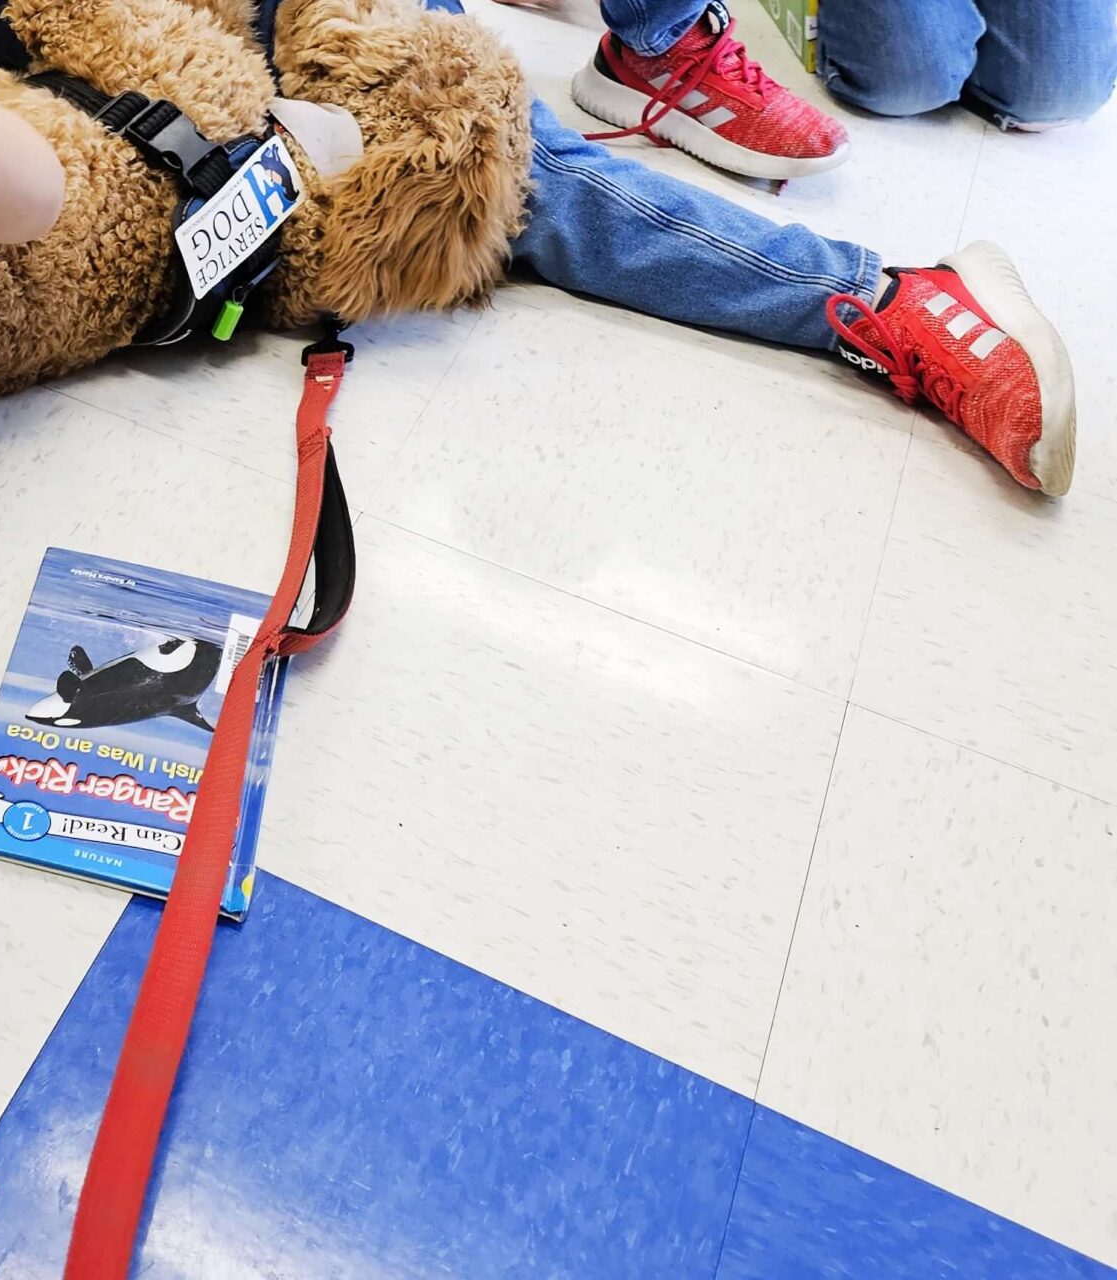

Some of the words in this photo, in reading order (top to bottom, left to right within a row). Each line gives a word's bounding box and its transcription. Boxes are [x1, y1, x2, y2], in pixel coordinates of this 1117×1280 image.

[191, 191, 252, 262] DOG
[196, 216, 265, 289] SERVICE
[838, 345, 889, 375] idas
[97, 572, 125, 585] Sandra
[6, 724, 60, 751] Orca
[65, 738, 93, 756] an
[98, 745, 145, 770] Was
[6, 757, 76, 791] Rick
[77, 775, 195, 823] Ranger
[20, 811, 36, 831] 1
[61, 817, 127, 843] Read!
[135, 827, 182, 851] Can
[73, 848, 123, 867] NATURE
